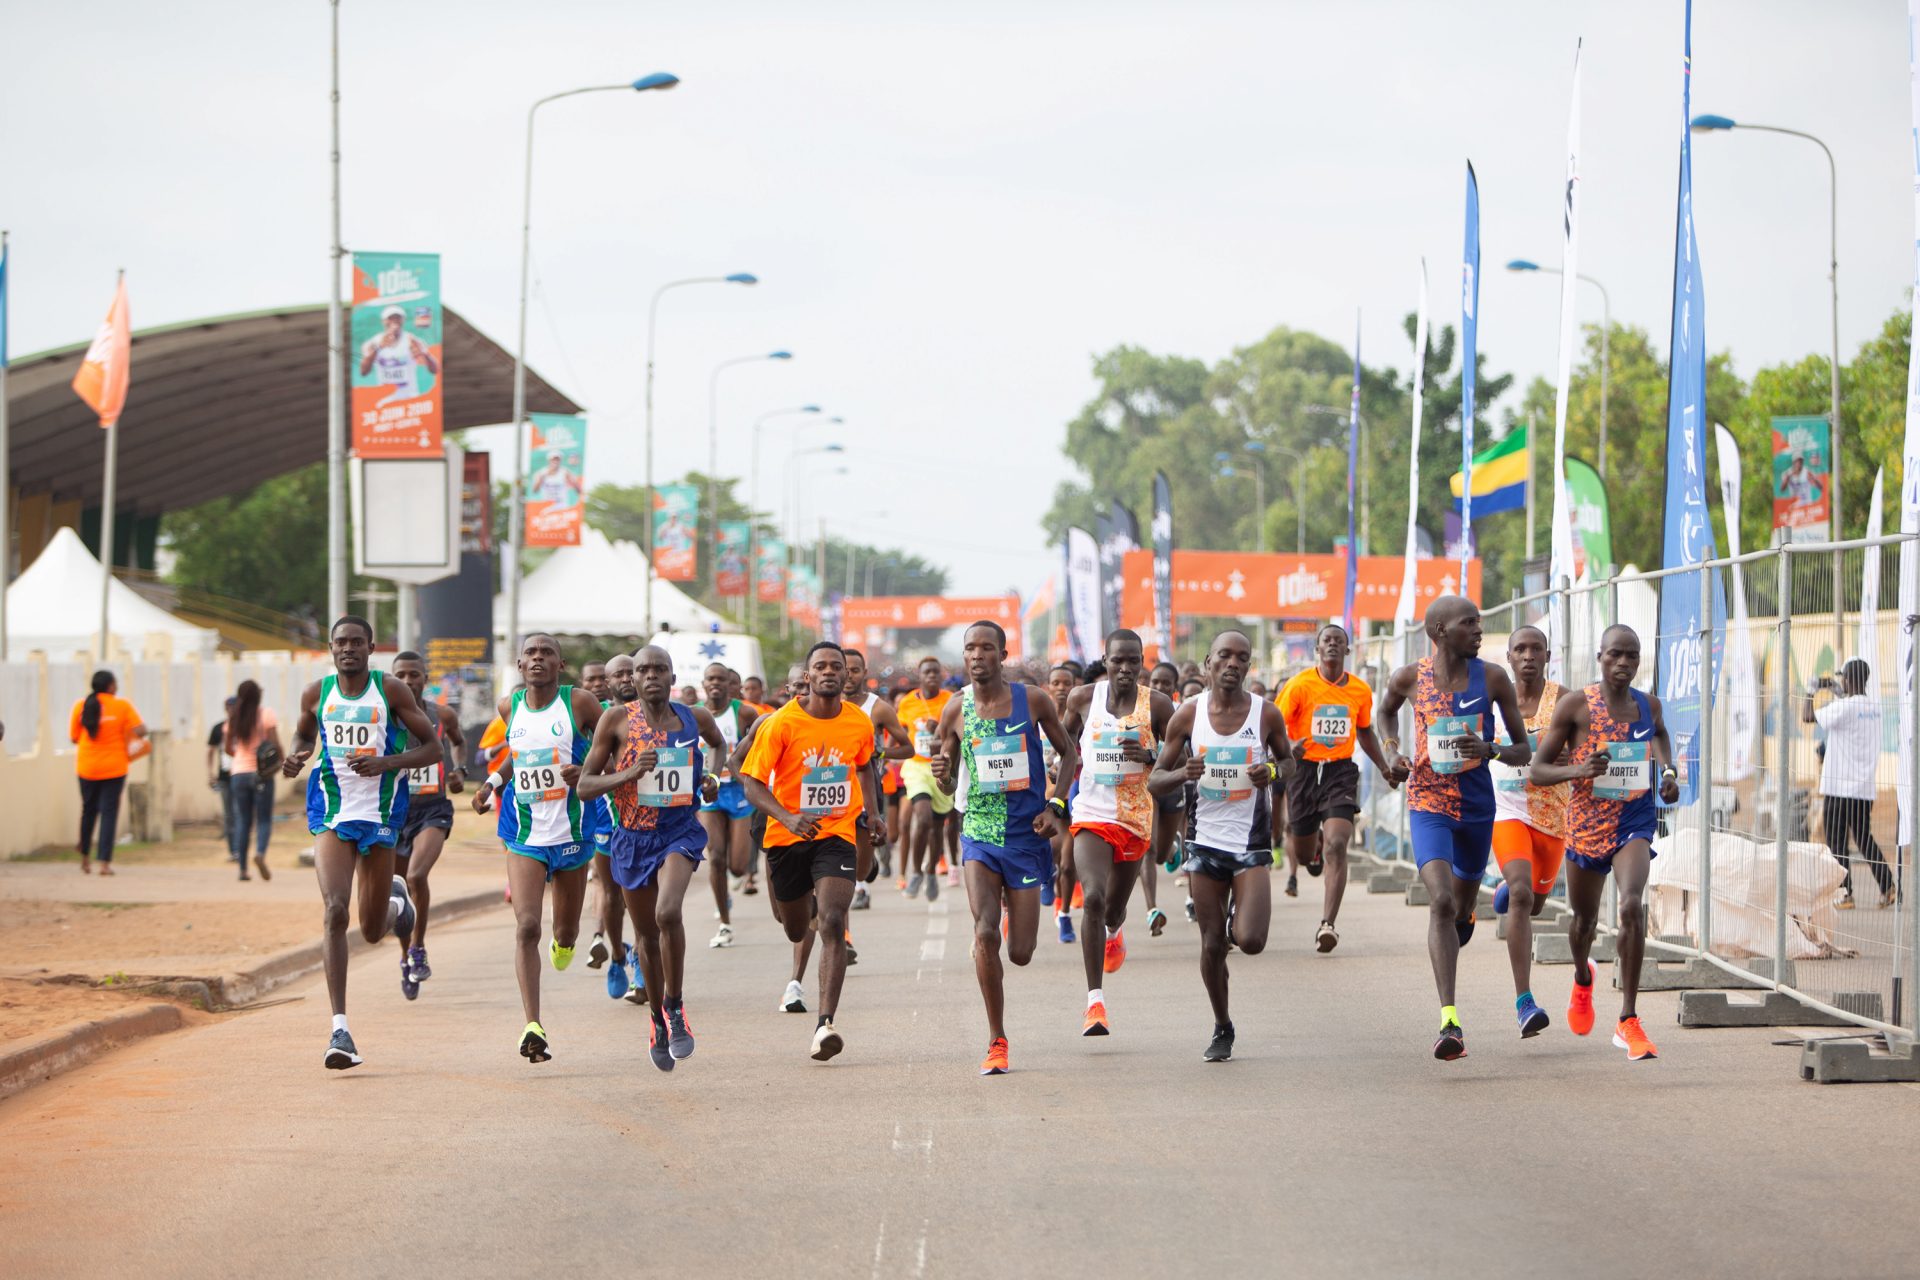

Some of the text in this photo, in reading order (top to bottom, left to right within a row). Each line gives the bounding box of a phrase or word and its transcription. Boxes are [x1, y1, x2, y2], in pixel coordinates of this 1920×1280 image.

[1666, 638, 1690, 702] 10
[1316, 719, 1346, 735] 1323
[333, 724, 369, 746] 810
[1453, 750, 1459, 759] 6
[987, 758, 1014, 770] NGENO
[1115, 763, 1120, 772] 7
[405, 767, 430, 783] 41
[999, 770, 1004, 778] 2
[1210, 768, 1238, 779] BIRECH
[1609, 766, 1639, 777] KORTEK
[519, 768, 555, 791] 819
[654, 769, 680, 792] 10
[1222, 779, 1227, 787] 5
[1622, 777, 1626, 786] 1
[807, 784, 846, 806] 7699
